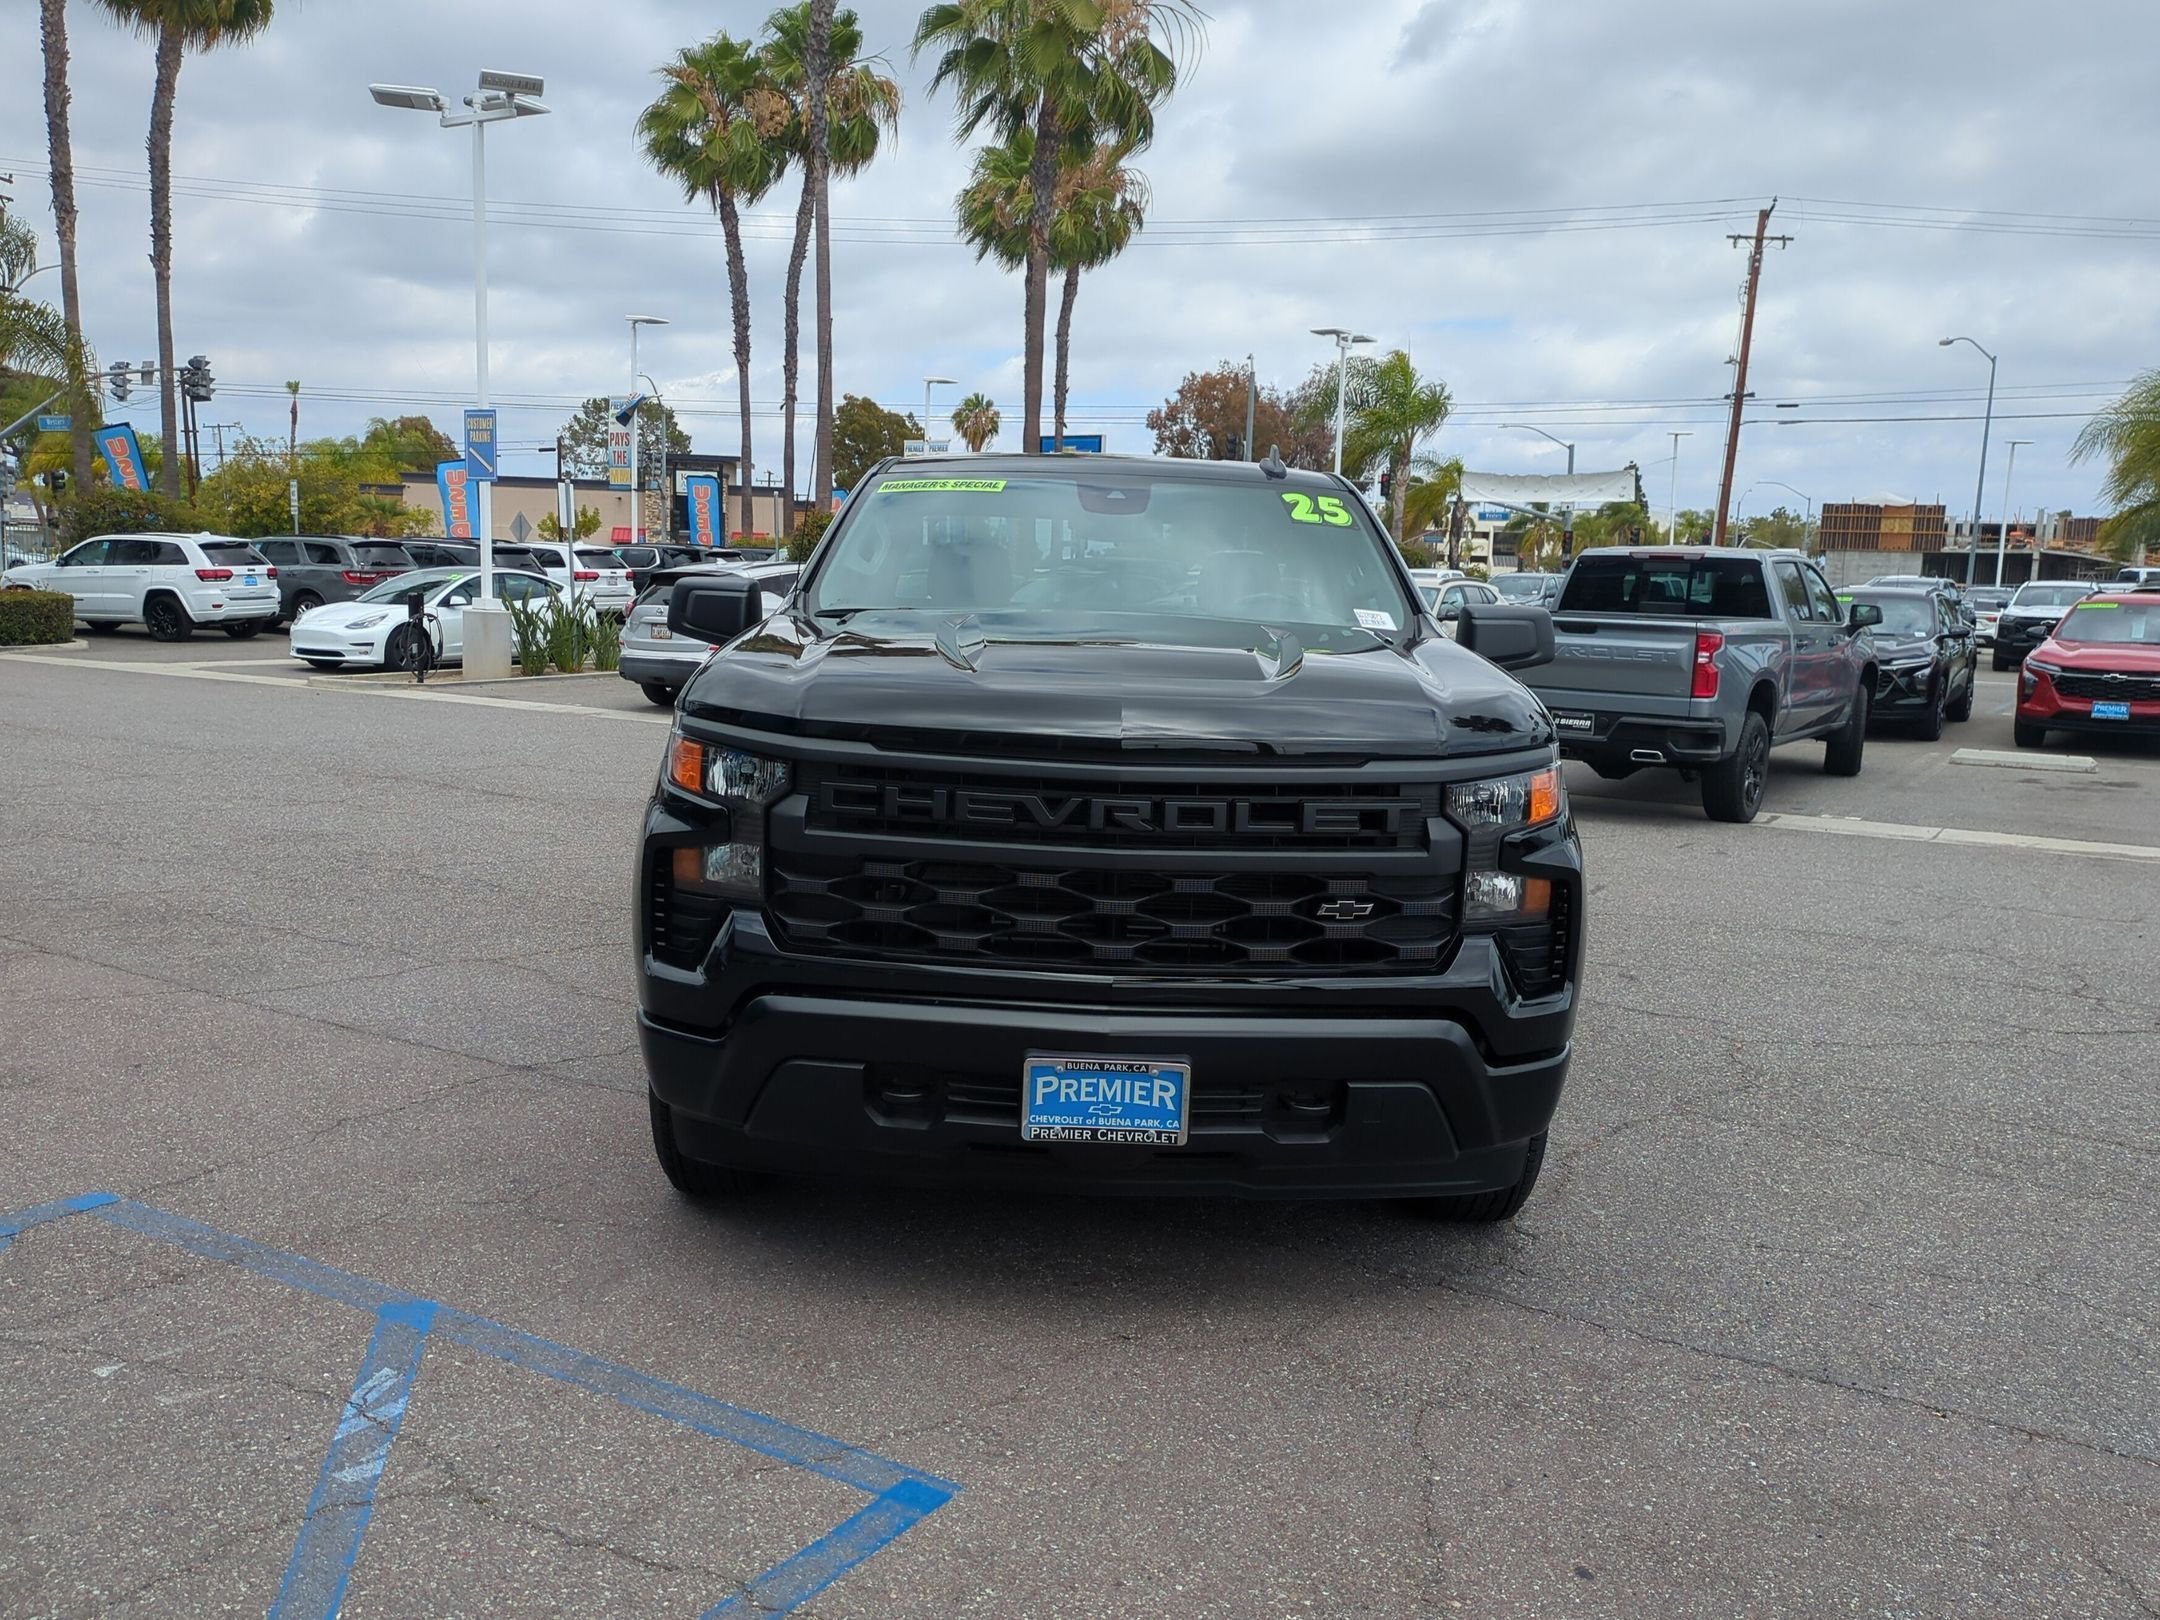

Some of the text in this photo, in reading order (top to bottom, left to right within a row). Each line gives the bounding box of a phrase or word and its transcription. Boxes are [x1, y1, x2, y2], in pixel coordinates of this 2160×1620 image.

[467, 417, 492, 430] CUSTOMER
[469, 431, 490, 443] PARKING
[610, 432, 630, 447] PAYS
[612, 450, 628, 465] THE
[881, 481, 1000, 490] MANAGER'S SPECIAL
[1281, 493, 1353, 527] 25
[2094, 704, 2128, 713] PREMIER
[1560, 718, 1591, 727] SIERRA
[820, 781, 1421, 833] CHEVROLET
[1067, 1062, 1100, 1071] BUENA
[1034, 1076, 1176, 1111] PREMIER
[1029, 1114, 1180, 1129] CHEVROLET of BUENA PARK, CA
[1030, 1127, 1178, 1144] PREMIER CHEVROLET
